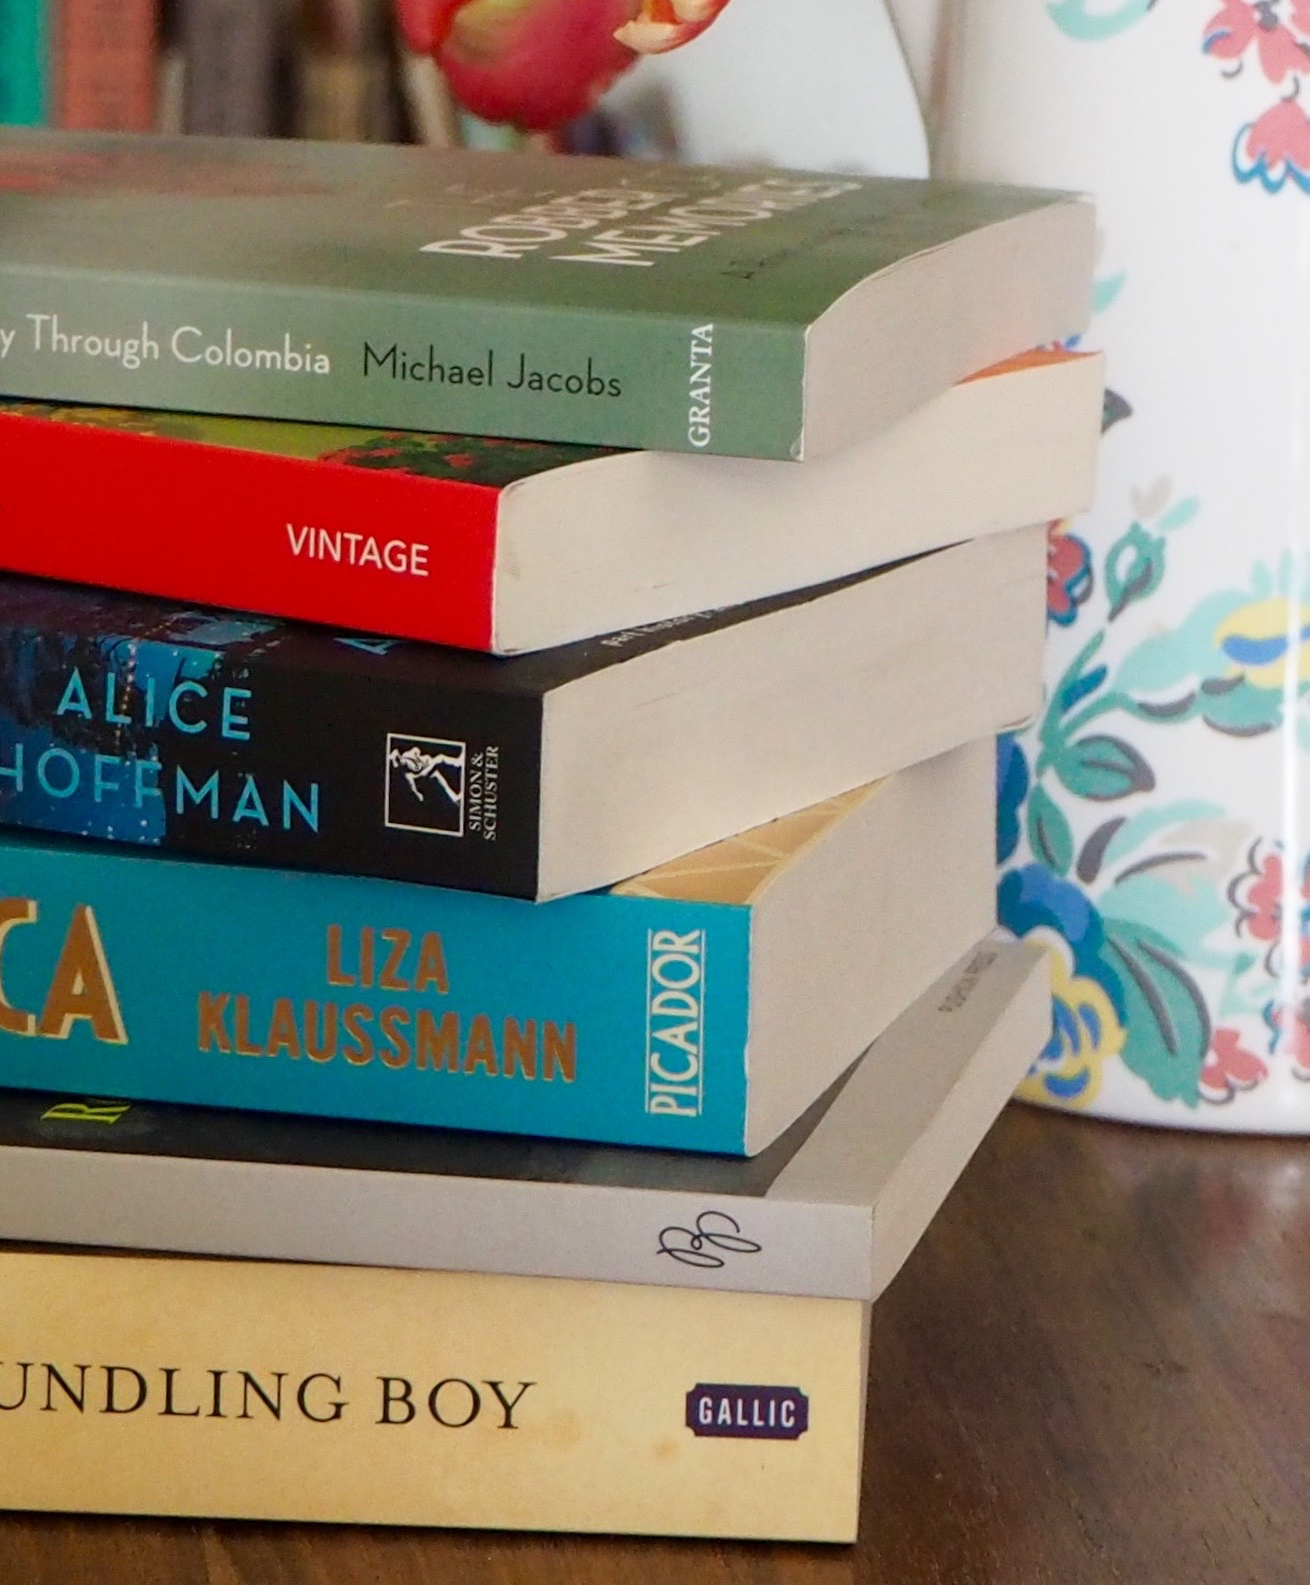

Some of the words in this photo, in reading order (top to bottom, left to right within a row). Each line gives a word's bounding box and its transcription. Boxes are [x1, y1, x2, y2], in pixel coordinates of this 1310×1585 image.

[25, 313, 160, 370] Through
[171, 325, 332, 375] Colombia
[361, 341, 495, 388] Michael
[506, 353, 623, 399] Jacobs
[687, 322, 715, 448] GRANTA
[286, 522, 430, 577] VINTAGE
[56, 665, 254, 742] ALICE
[471, 751, 484, 768] &
[483, 745, 499, 841] SCHUSTER
[469, 768, 483, 832] SIMON
[325, 922, 451, 996] LIZA
[196, 988, 579, 1084] KLAUSSMANN
[648, 928, 701, 1120] PICADOR
[375, 1374, 539, 1431] BOY
[697, 1395, 797, 1429] GALLIC
